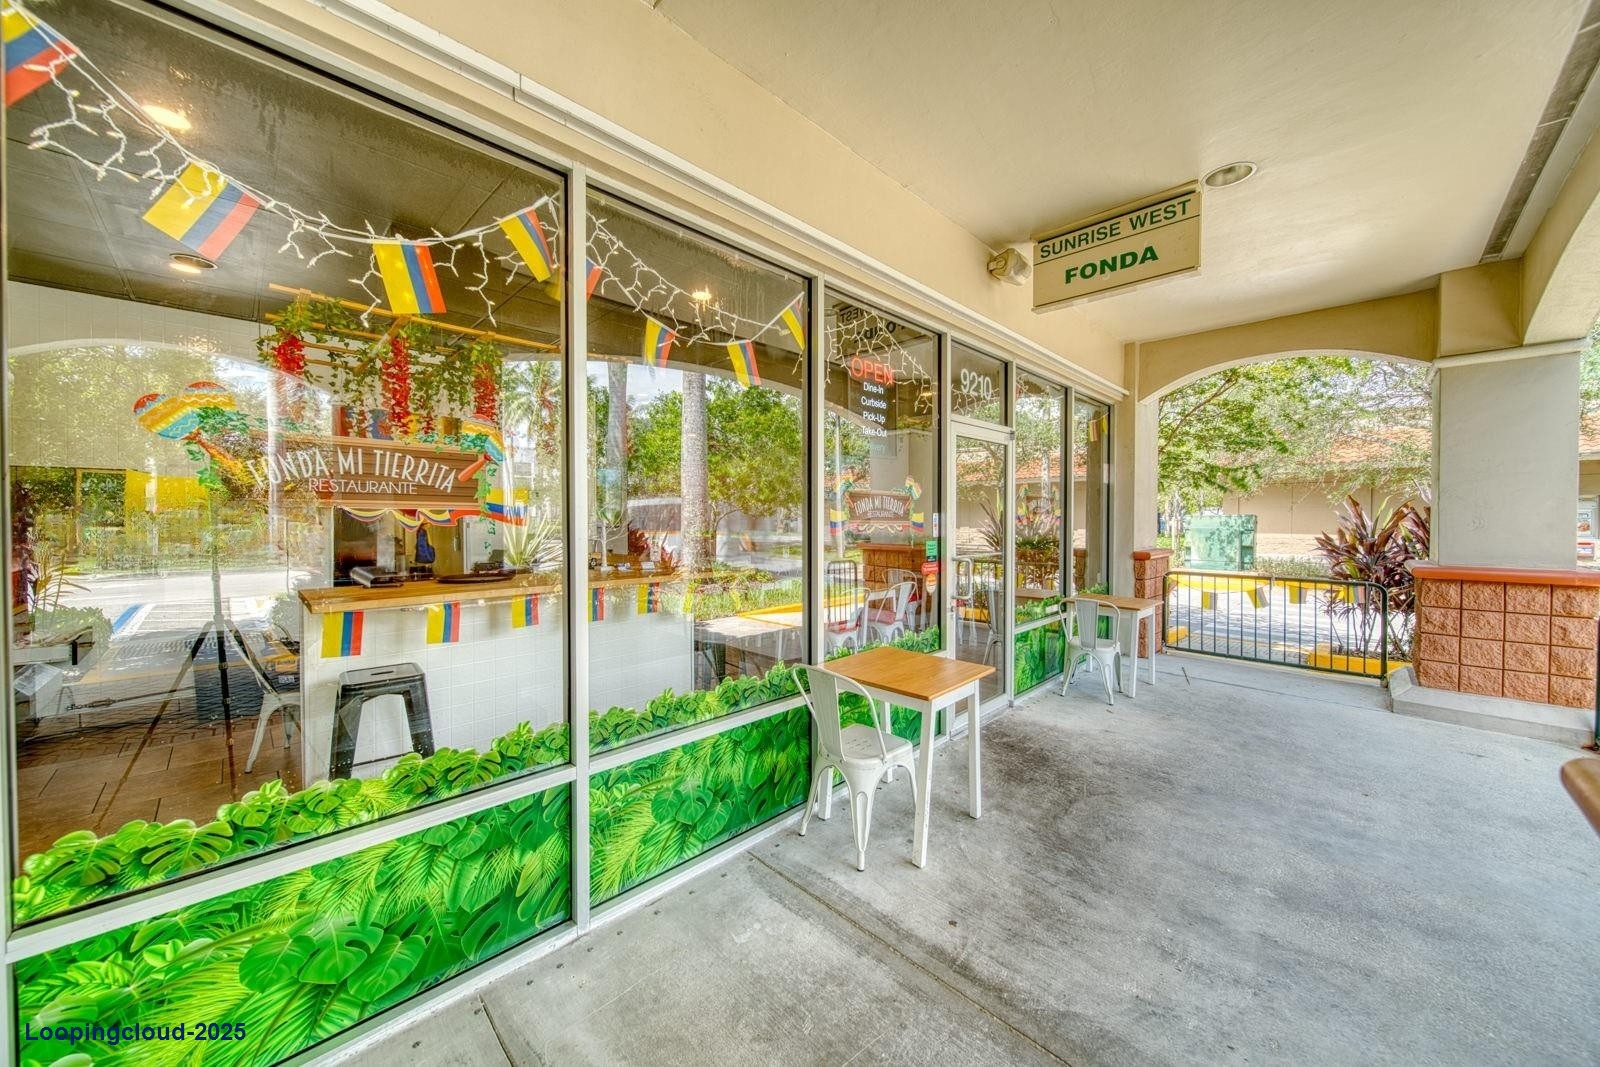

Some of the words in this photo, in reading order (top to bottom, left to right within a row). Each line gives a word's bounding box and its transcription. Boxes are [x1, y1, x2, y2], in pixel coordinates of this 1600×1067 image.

[1040, 221, 1121, 259] SUNRISE
[1129, 199, 1192, 231] WEST
[1065, 245, 1159, 284] FONDA
[851, 357, 894, 385] OPEN
[863, 382, 884, 394] Dine-In
[960, 368, 992, 400] 9210
[861, 396, 887, 409] Curbside
[863, 411, 885, 424] Pick-Up
[862, 425, 887, 437] Take-Out
[246, 446, 331, 490] FONDA
[338, 447, 363, 475] MI
[375, 449, 459, 493] TIERRITA
[308, 478, 418, 495] RESTAURANTE
